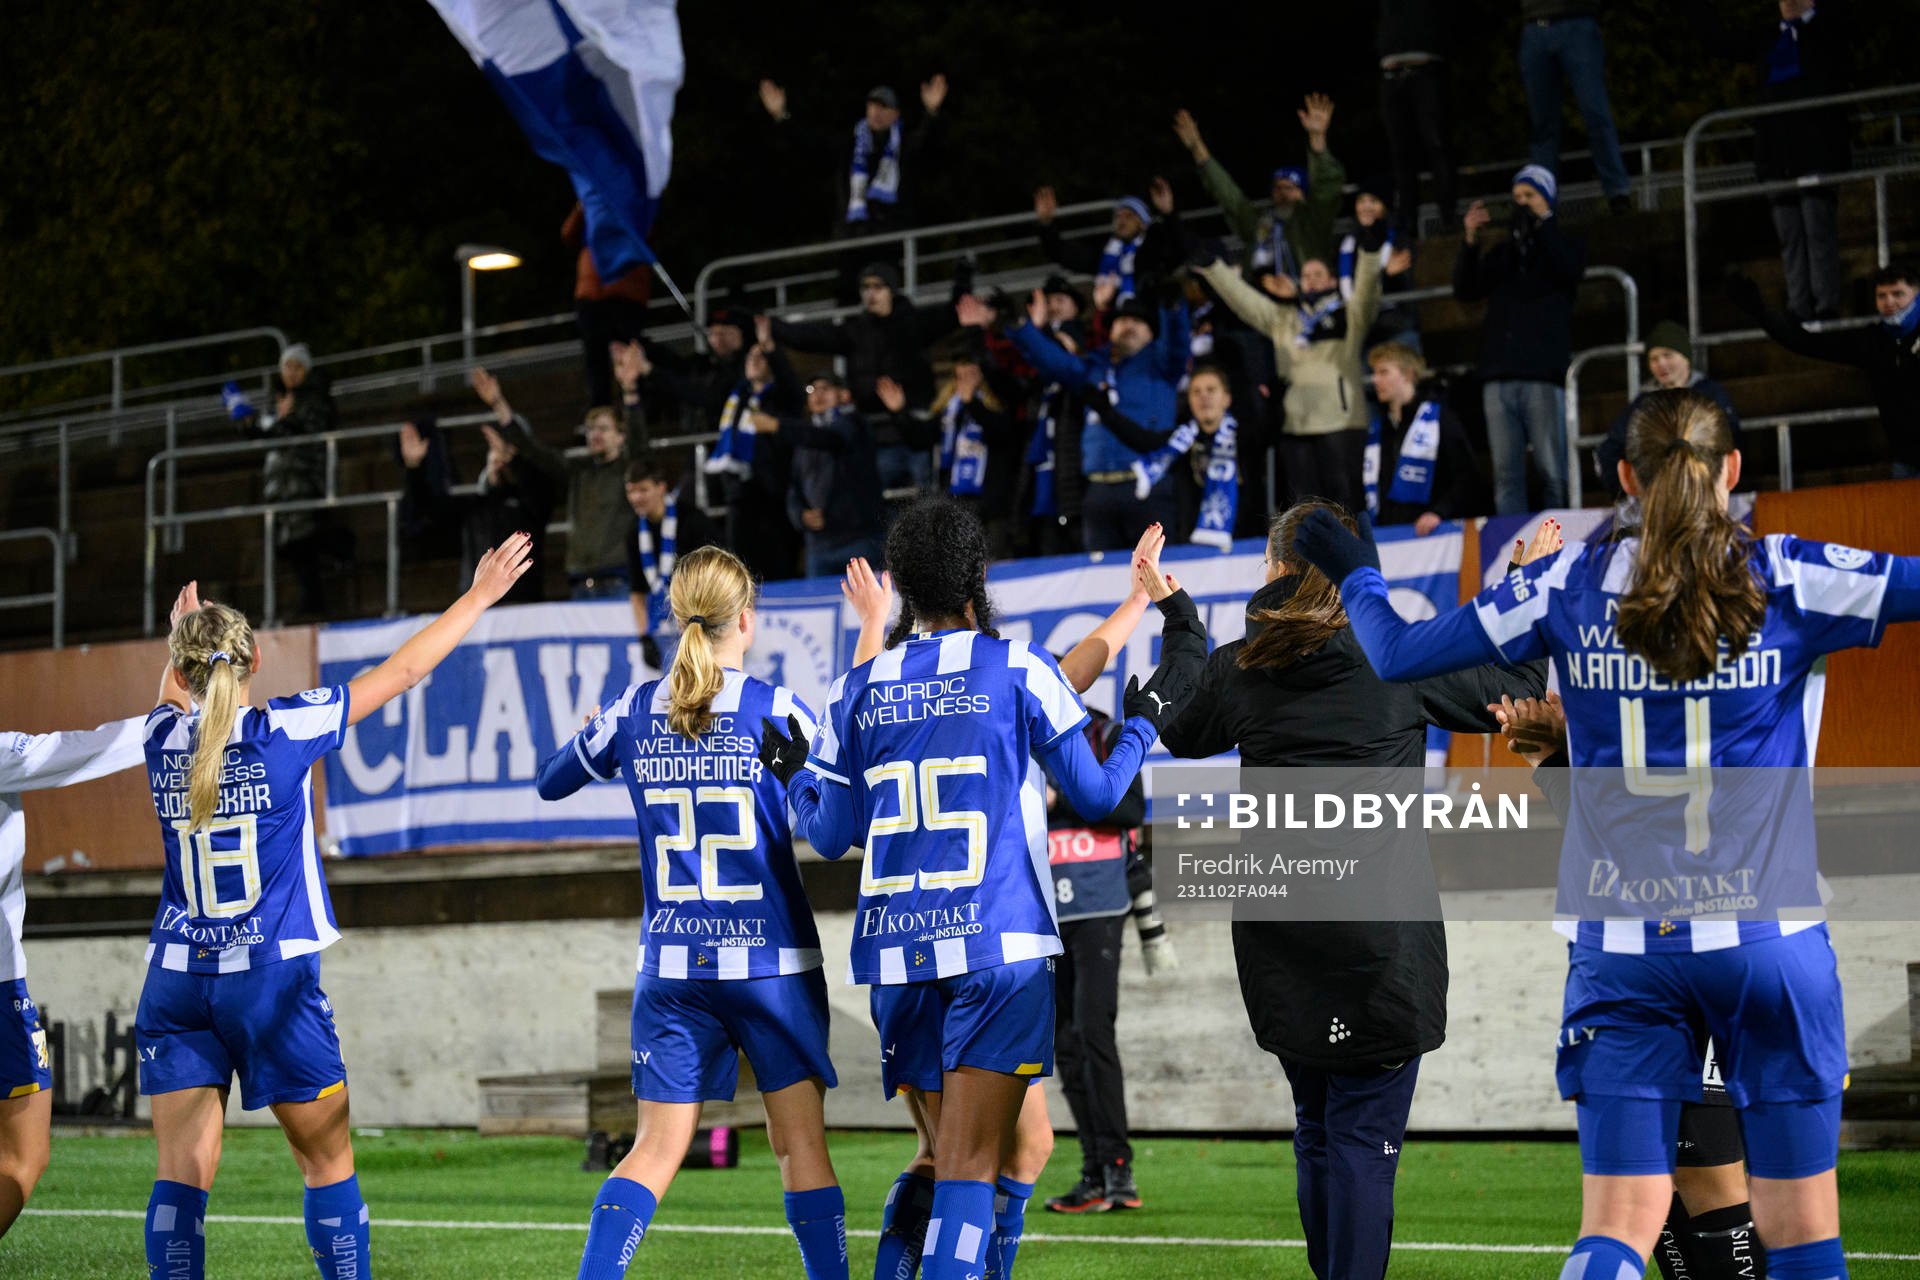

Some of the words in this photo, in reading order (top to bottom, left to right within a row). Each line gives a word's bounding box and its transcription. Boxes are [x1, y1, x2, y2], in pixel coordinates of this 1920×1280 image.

[1566, 649, 1782, 692] N.ANDESON
[870, 676, 966, 706] NORDIC
[337, 642, 662, 795] CLAV
[855, 694, 990, 731] WELLNESS
[163, 748, 242, 771] NOIC
[635, 735, 755, 756] WELLNESS
[152, 762, 267, 790] WELESS
[633, 755, 764, 784] BRODDHEIMER
[1619, 696, 1713, 856] 4
[152, 782, 272, 818] FJORKÄR
[861, 756, 988, 899] 25
[643, 786, 764, 904] 22
[1049, 832, 1096, 861] TO
[171, 813, 262, 919] 18
[1694, 895, 1759, 914] INSTALCO
[721, 936, 767, 947] INSTALCO
[935, 922, 983, 939] INSTALCO
[1731, 1230, 1757, 1280] SILFV
